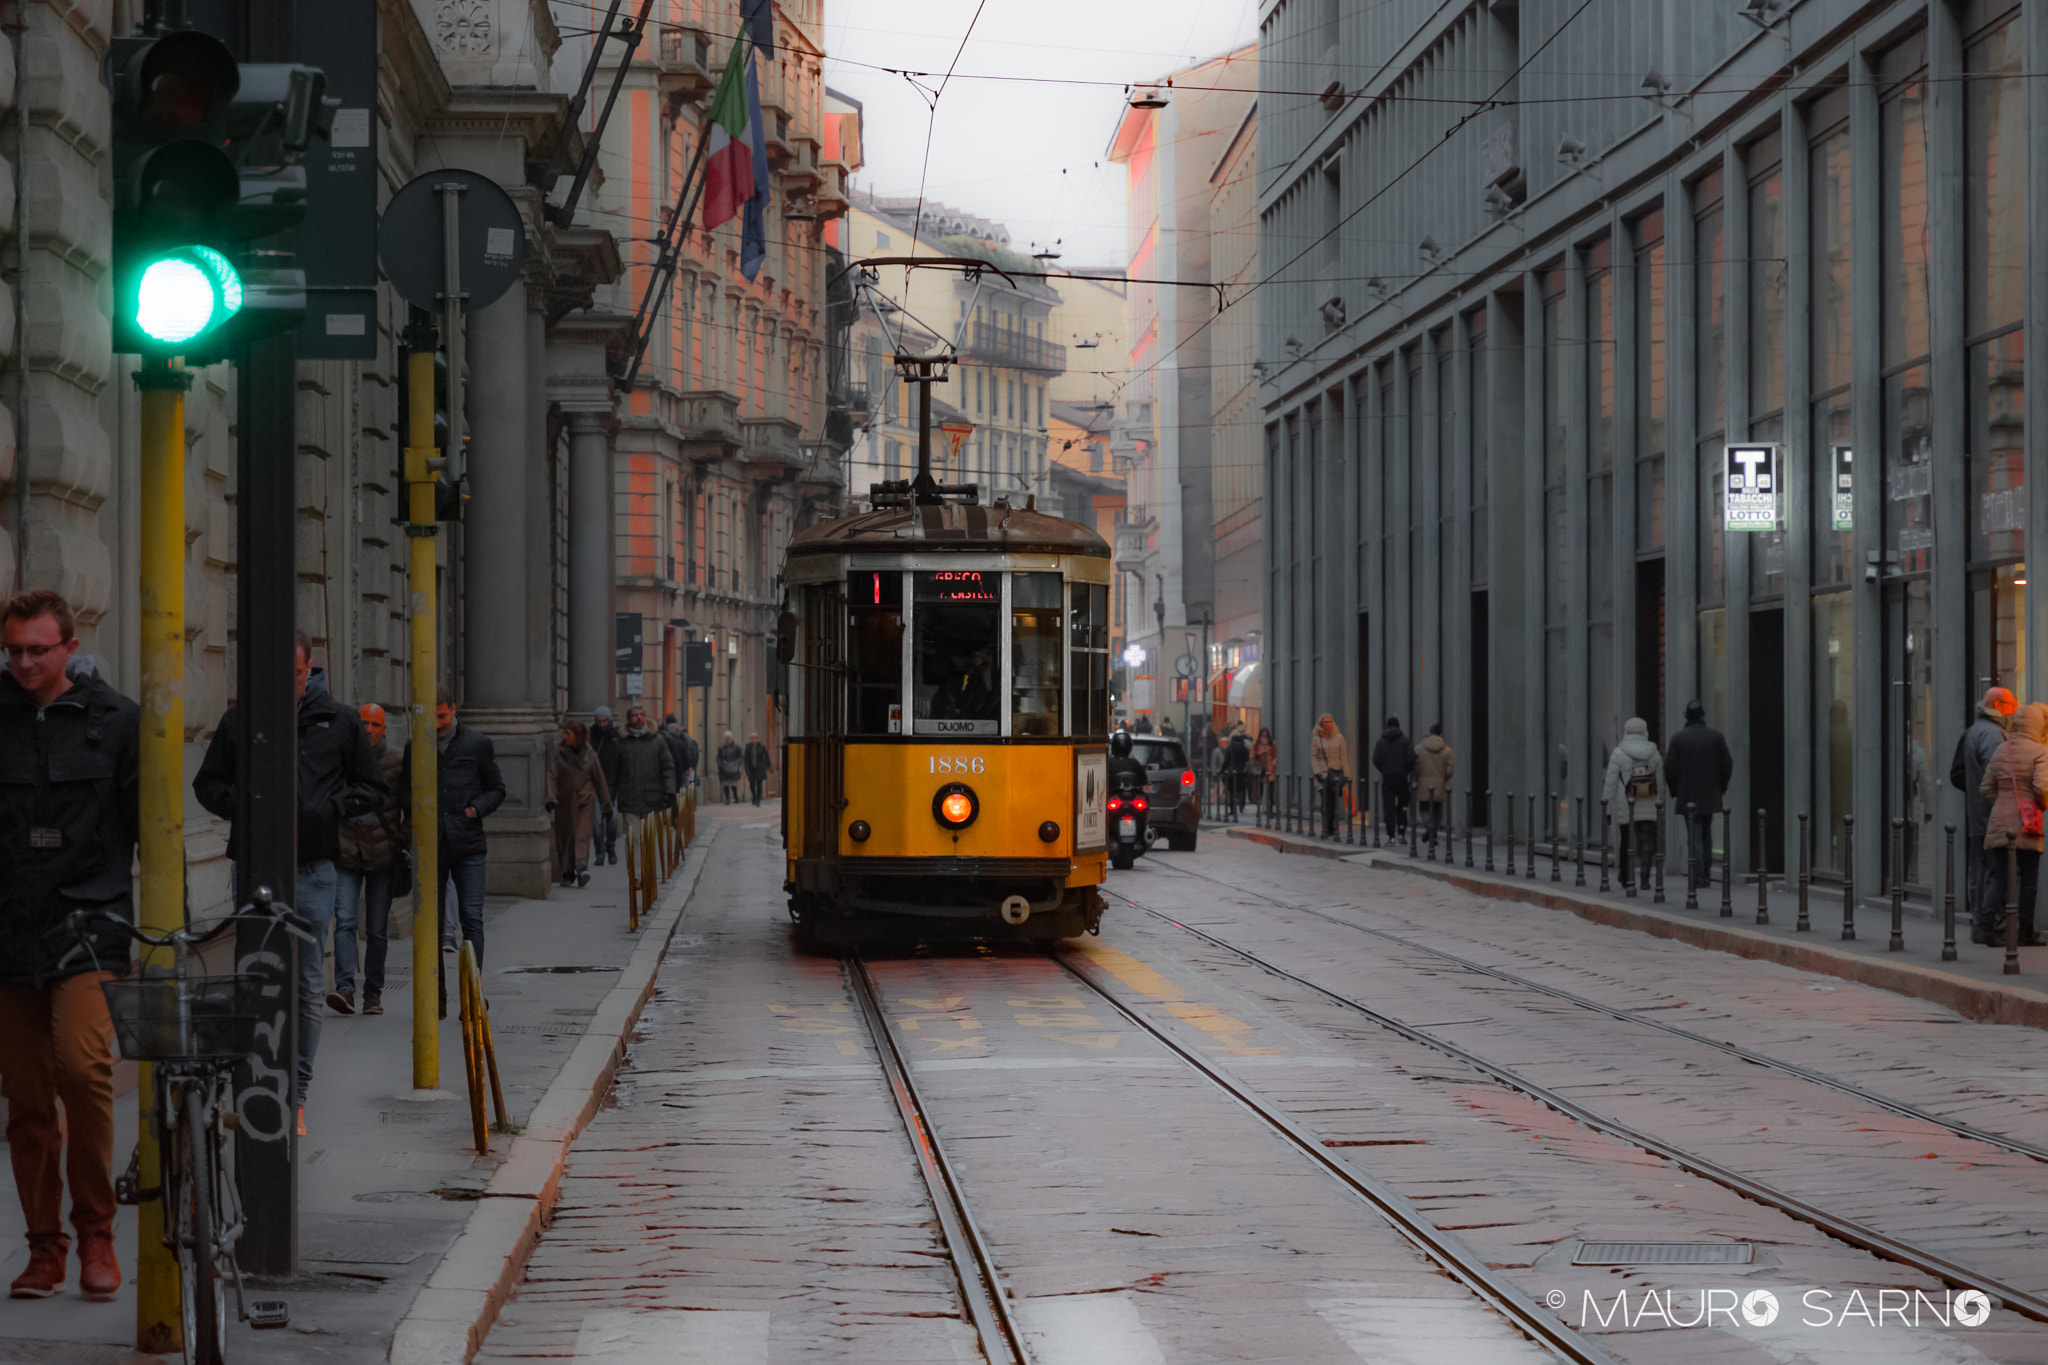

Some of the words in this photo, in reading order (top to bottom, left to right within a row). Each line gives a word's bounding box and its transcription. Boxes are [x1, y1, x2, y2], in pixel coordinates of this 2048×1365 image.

[1734, 450, 1766, 488] T
[1729, 493, 1773, 504] TABACCHI
[1729, 511, 1771, 520] LOTTO
[873, 572, 880, 604] 1
[938, 722, 974, 731] DUOMO
[929, 756, 985, 774] 1886
